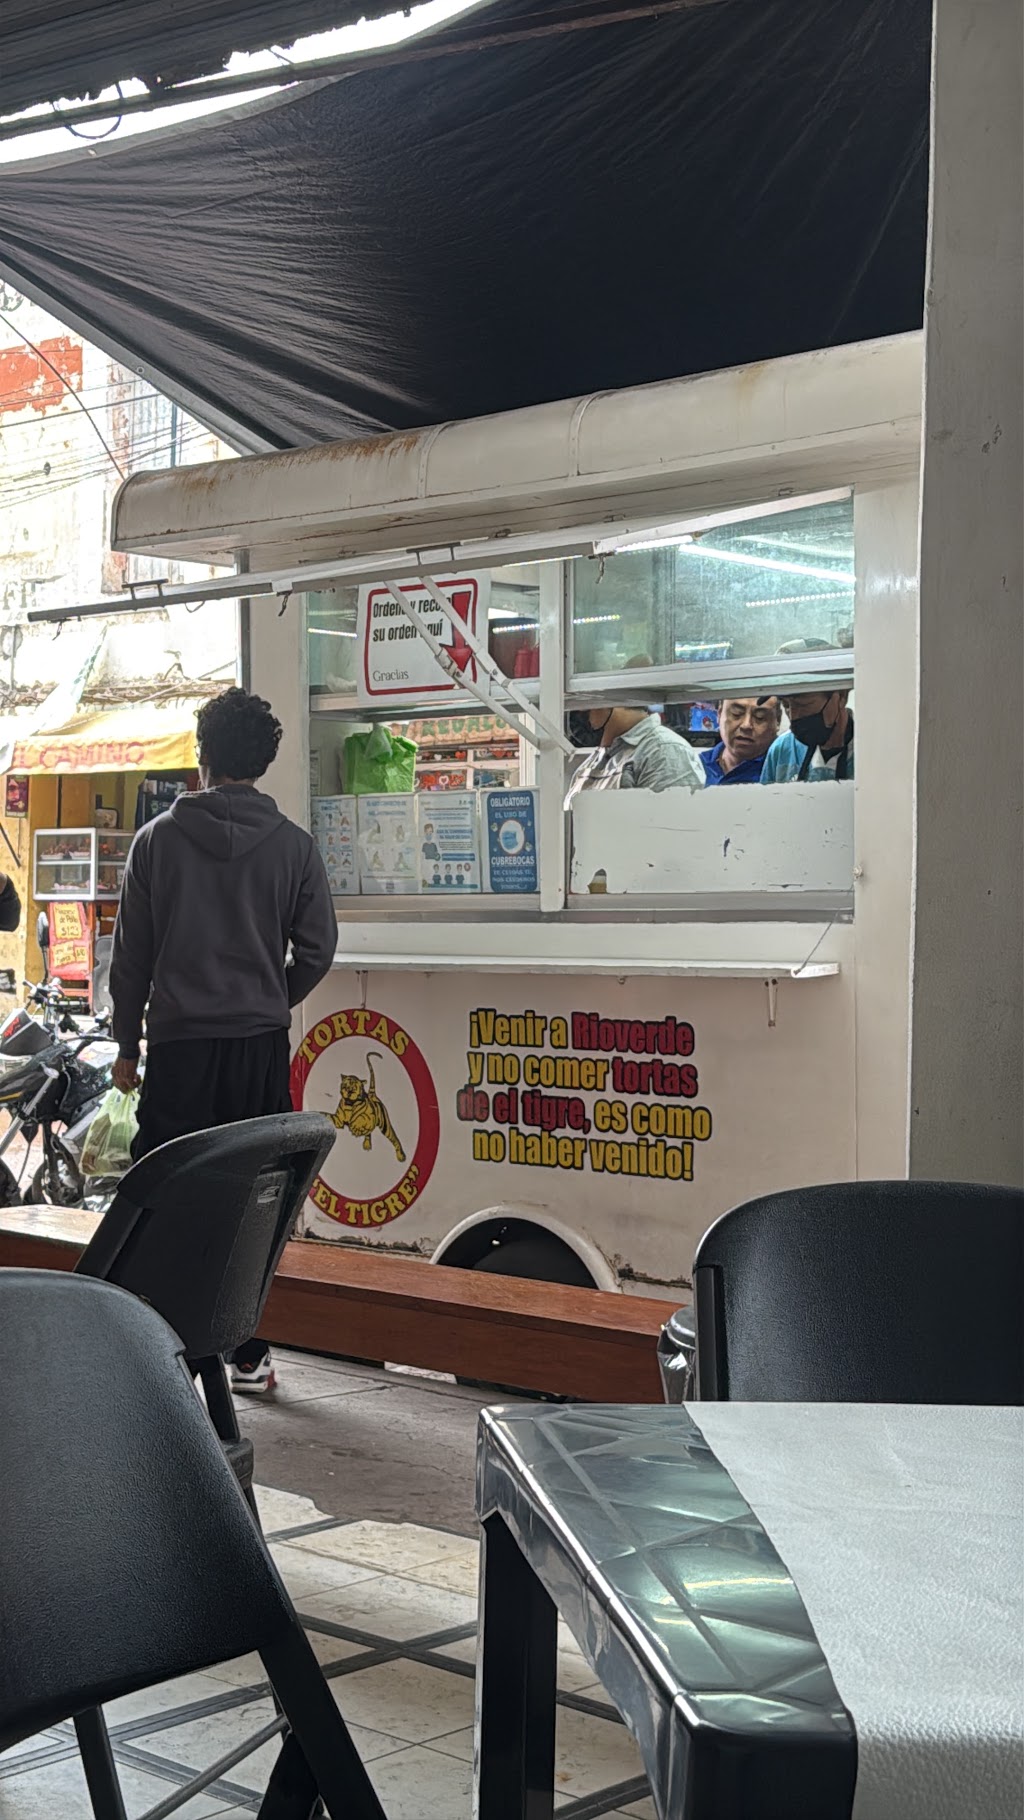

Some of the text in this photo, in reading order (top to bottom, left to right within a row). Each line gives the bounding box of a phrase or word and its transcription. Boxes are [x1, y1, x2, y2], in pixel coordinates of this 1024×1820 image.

[373, 601, 408, 618] Orden
[418, 597, 451, 613] reco
[372, 618, 444, 642] su orden quí
[372, 669, 409, 682] Gracias
[490, 797, 531, 808] OBLIGATORIO
[491, 856, 535, 866] CUBREBOCAS
[299, 1010, 410, 1064] TORTAS
[470, 1009, 695, 1056] ¡Venir a Rioverde
[467, 1052, 699, 1098] y no comer tortas
[456, 1084, 712, 1141] de el tigre, es como
[472, 1126, 694, 1182] no haber venido!
